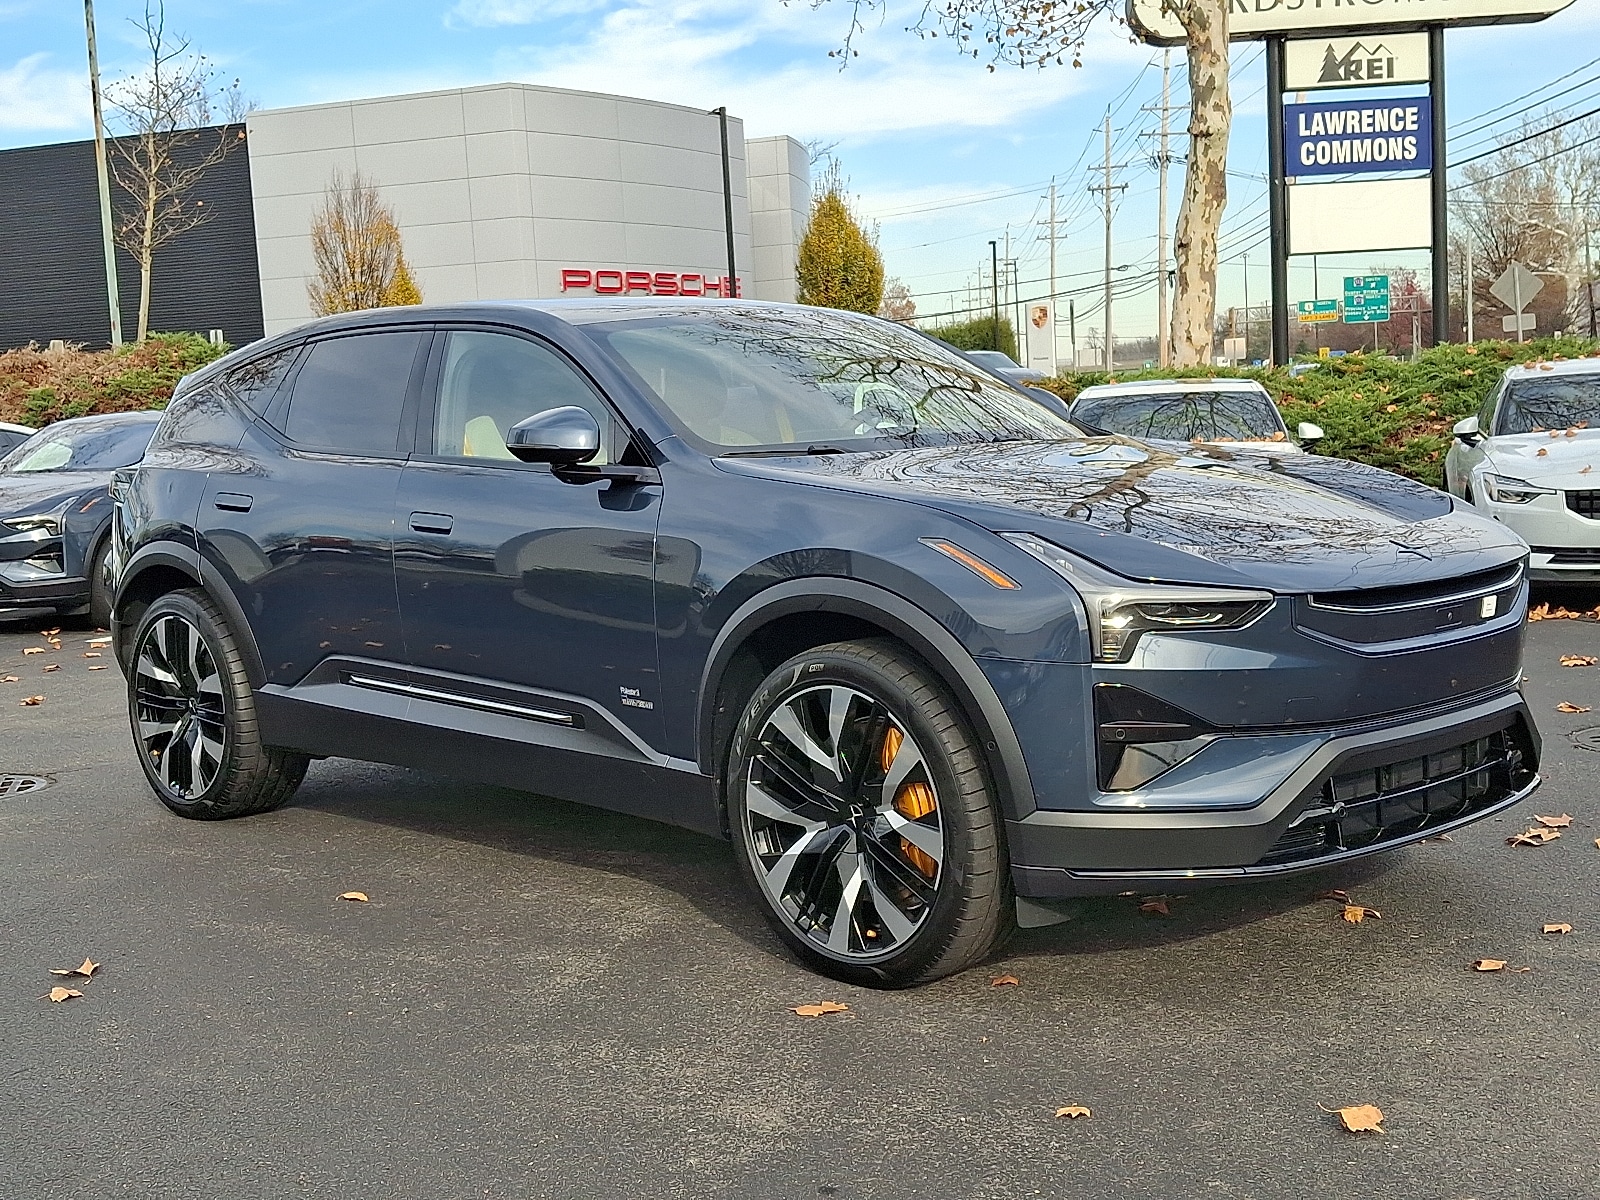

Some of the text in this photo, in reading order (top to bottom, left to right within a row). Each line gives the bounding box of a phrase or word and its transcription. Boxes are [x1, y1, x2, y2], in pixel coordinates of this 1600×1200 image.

[1343, 56, 1395, 81] REI
[1299, 106, 1419, 136] LAWRENCE
[1300, 136, 1418, 166] COMMONS
[560, 269, 742, 298] PORSCHE
